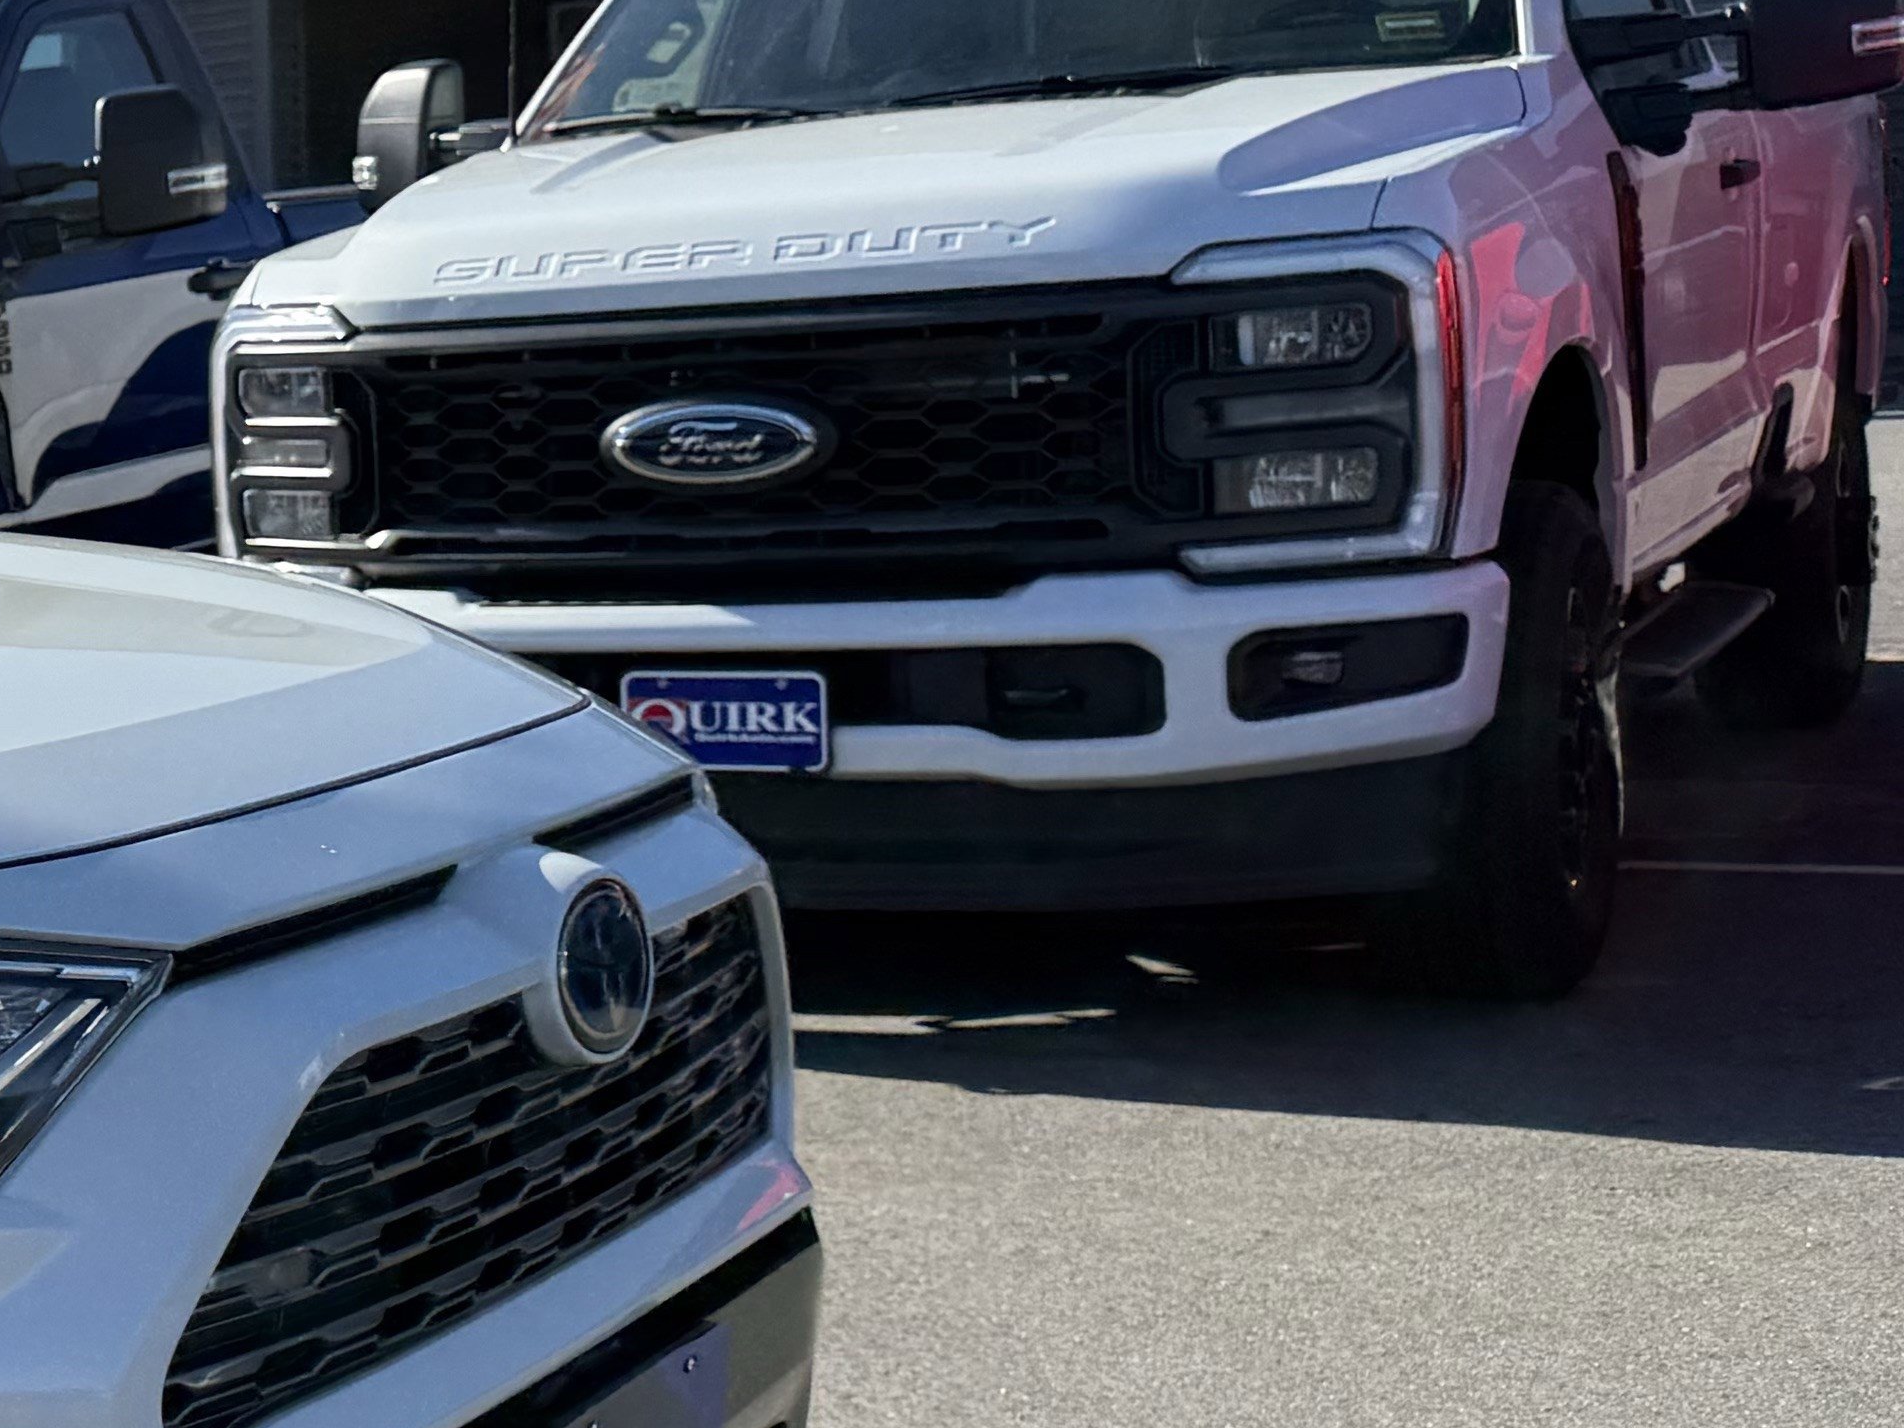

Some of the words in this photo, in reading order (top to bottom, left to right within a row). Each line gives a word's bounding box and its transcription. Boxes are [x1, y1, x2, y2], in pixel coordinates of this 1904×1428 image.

[433, 238, 755, 286] SUPER
[771, 214, 1058, 263] DUTY
[659, 421, 763, 466] Ford
